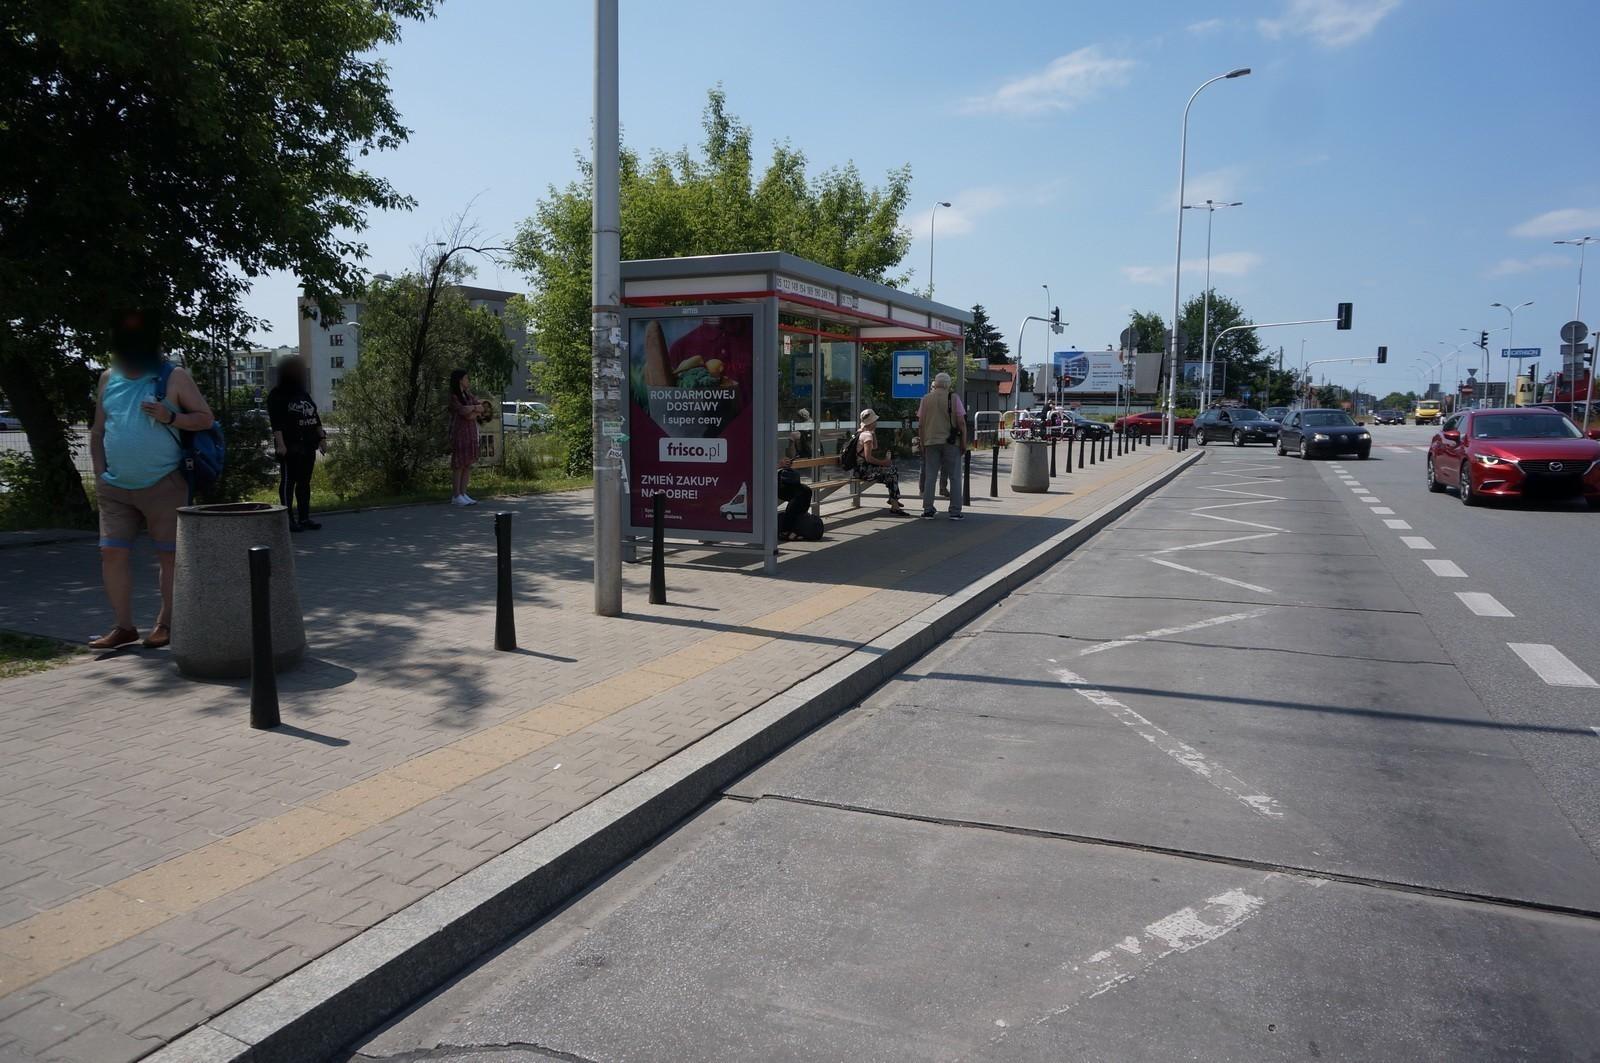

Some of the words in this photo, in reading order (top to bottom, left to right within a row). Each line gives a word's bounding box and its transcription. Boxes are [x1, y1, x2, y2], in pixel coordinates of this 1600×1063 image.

[650, 390, 672, 400] ROK
[674, 389, 736, 401] DARMOWEJ
[666, 401, 719, 412] DOSTAWY
[663, 414, 666, 424] i
[668, 416, 695, 426] super
[697, 416, 722, 427] ceny
[666, 442, 720, 460] frisco.pl
[641, 473, 674, 485] ZMIEŃ
[676, 476, 720, 487] ZAKUPY
[641, 488, 655, 498] NA
